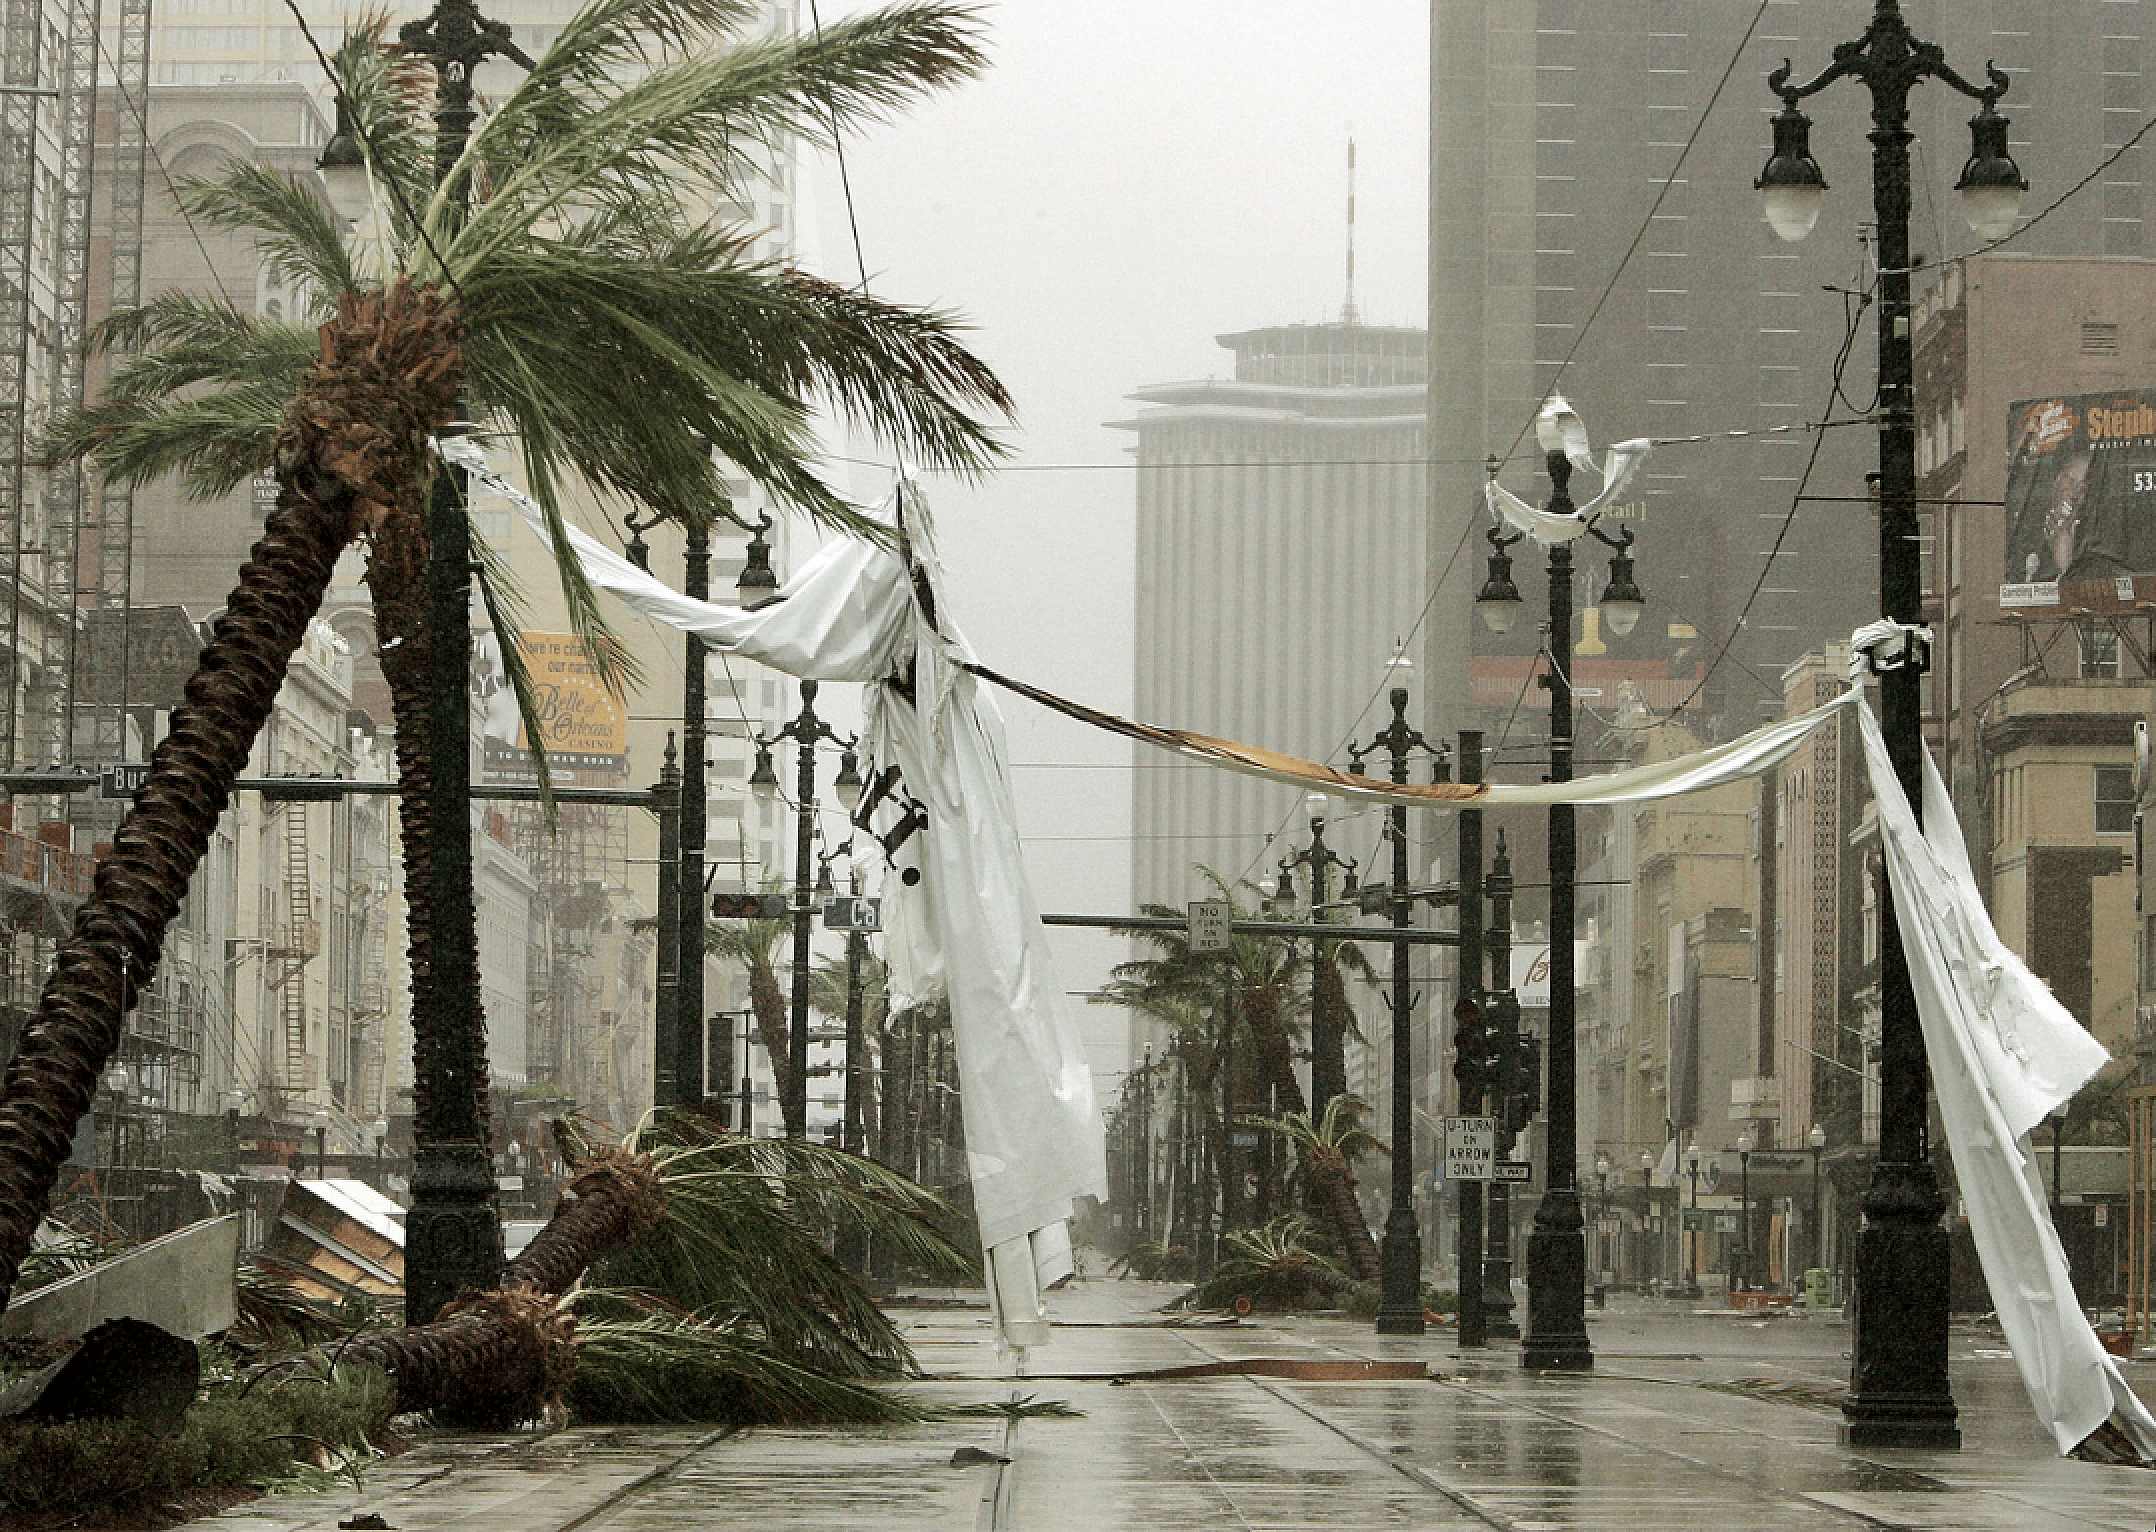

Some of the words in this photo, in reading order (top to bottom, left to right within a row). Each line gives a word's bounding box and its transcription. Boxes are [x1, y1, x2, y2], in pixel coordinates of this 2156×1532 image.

[2087, 404, 2156, 440] Steph
[2132, 471, 2156, 492] 53
[547, 661, 566, 673] our
[532, 682, 586, 722] Belle
[552, 712, 615, 743] Orleans
[568, 739, 614, 750] CASINO
[1200, 907, 1219, 917] NO
[1200, 939, 1221, 948] RED
[1447, 1119, 1493, 1133] U-TURN
[1462, 1134, 1477, 1145] ON
[1448, 1147, 1491, 1161] ARROW
[1453, 1162, 1485, 1177] ONLY
